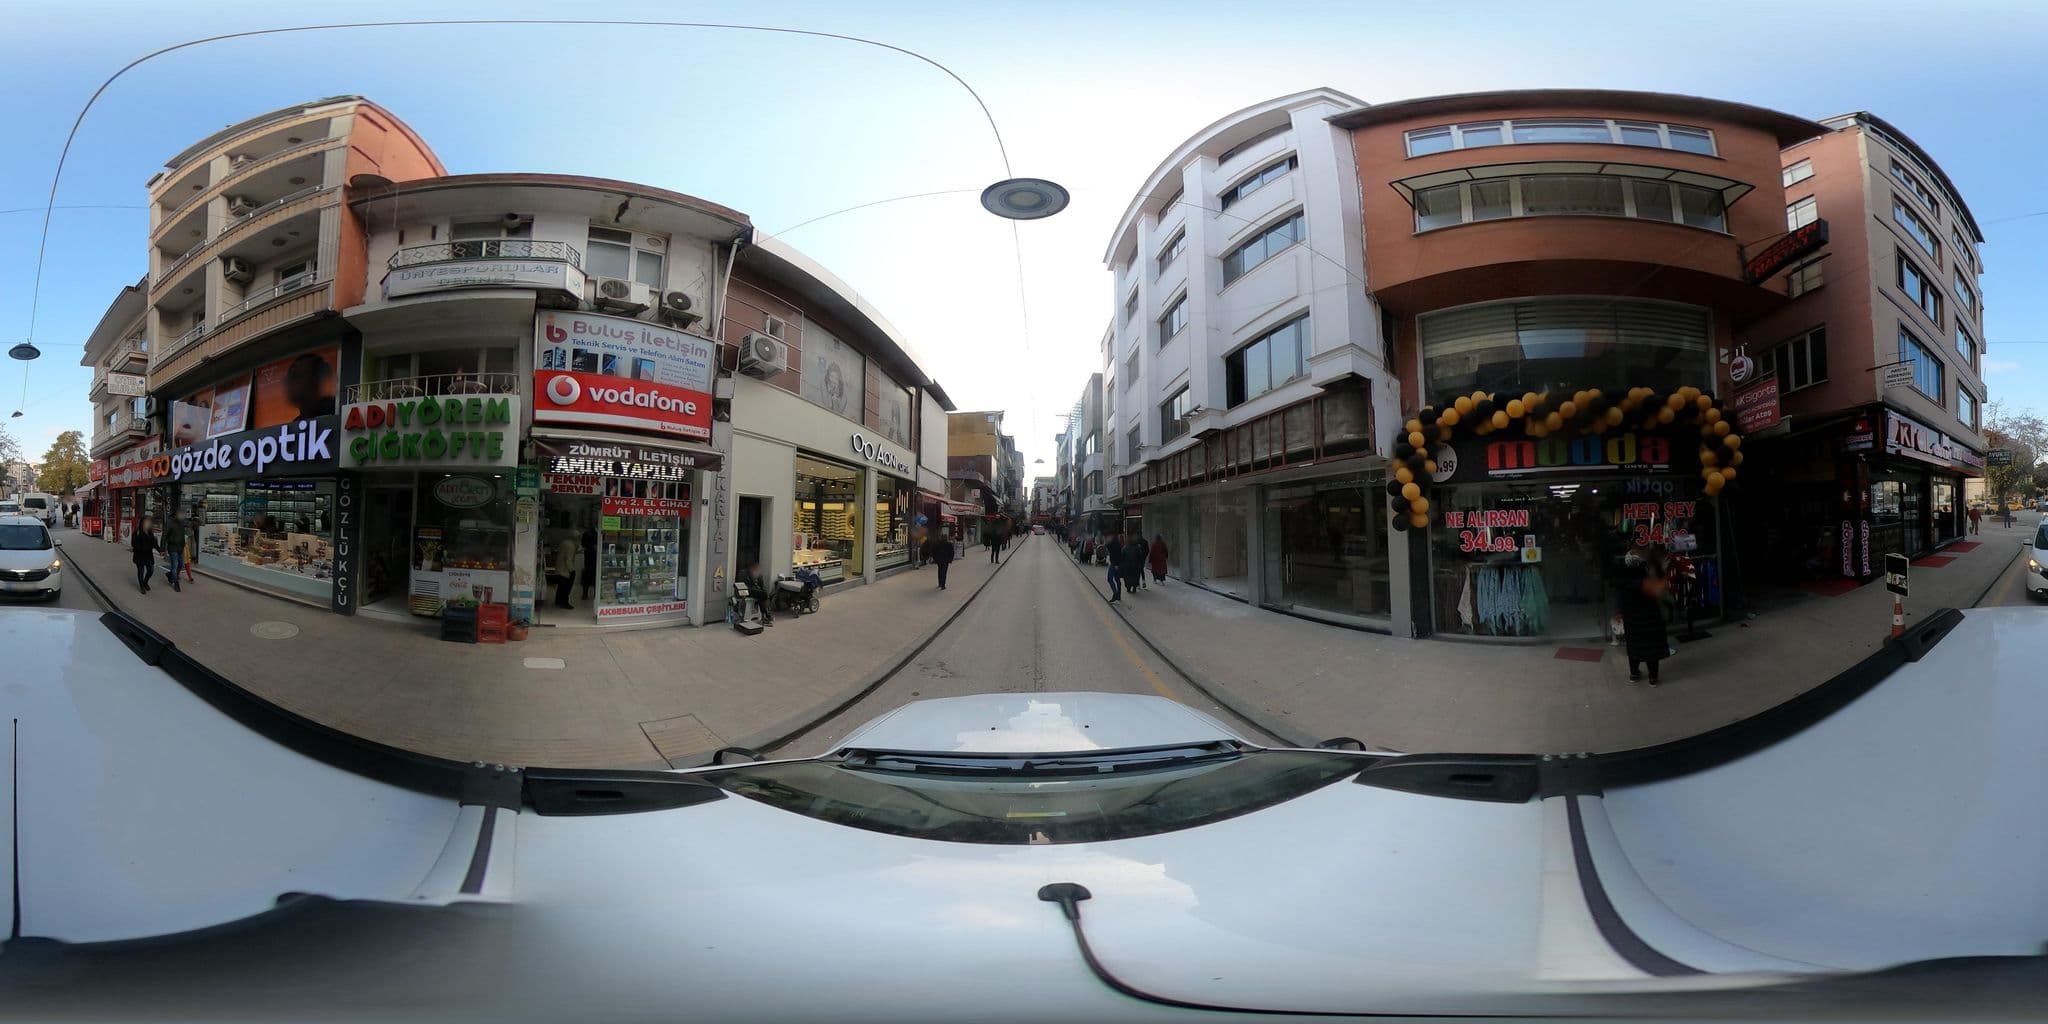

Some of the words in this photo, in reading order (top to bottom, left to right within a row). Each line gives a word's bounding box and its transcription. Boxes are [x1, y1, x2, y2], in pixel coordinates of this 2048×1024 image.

[572, 320, 635, 342] Buluş
[572, 338, 600, 349] Teknik
[601, 341, 627, 352] Servis
[640, 347, 668, 359] Telefon
[589, 386, 697, 416] vodafone
[344, 395, 511, 432] ADIYÖREM
[171, 439, 232, 480] gözde
[238, 420, 332, 473] optik
[569, 444, 631, 459] ZÜMRÜT
[638, 449, 695, 466] İLETİŞİM
[1436, 460, 1454, 473] .99
[616, 507, 644, 515] ALIM
[647, 508, 679, 517] SATIM
[630, 499, 640, 507] 2.
[1623, 503, 1660, 520] HER
[1445, 511, 1464, 528] NE
[1467, 509, 1529, 527] ALIRSAN
[338, 478, 350, 606] GÖZLÜKÇÜ
[599, 606, 645, 617] AKSESUAR
